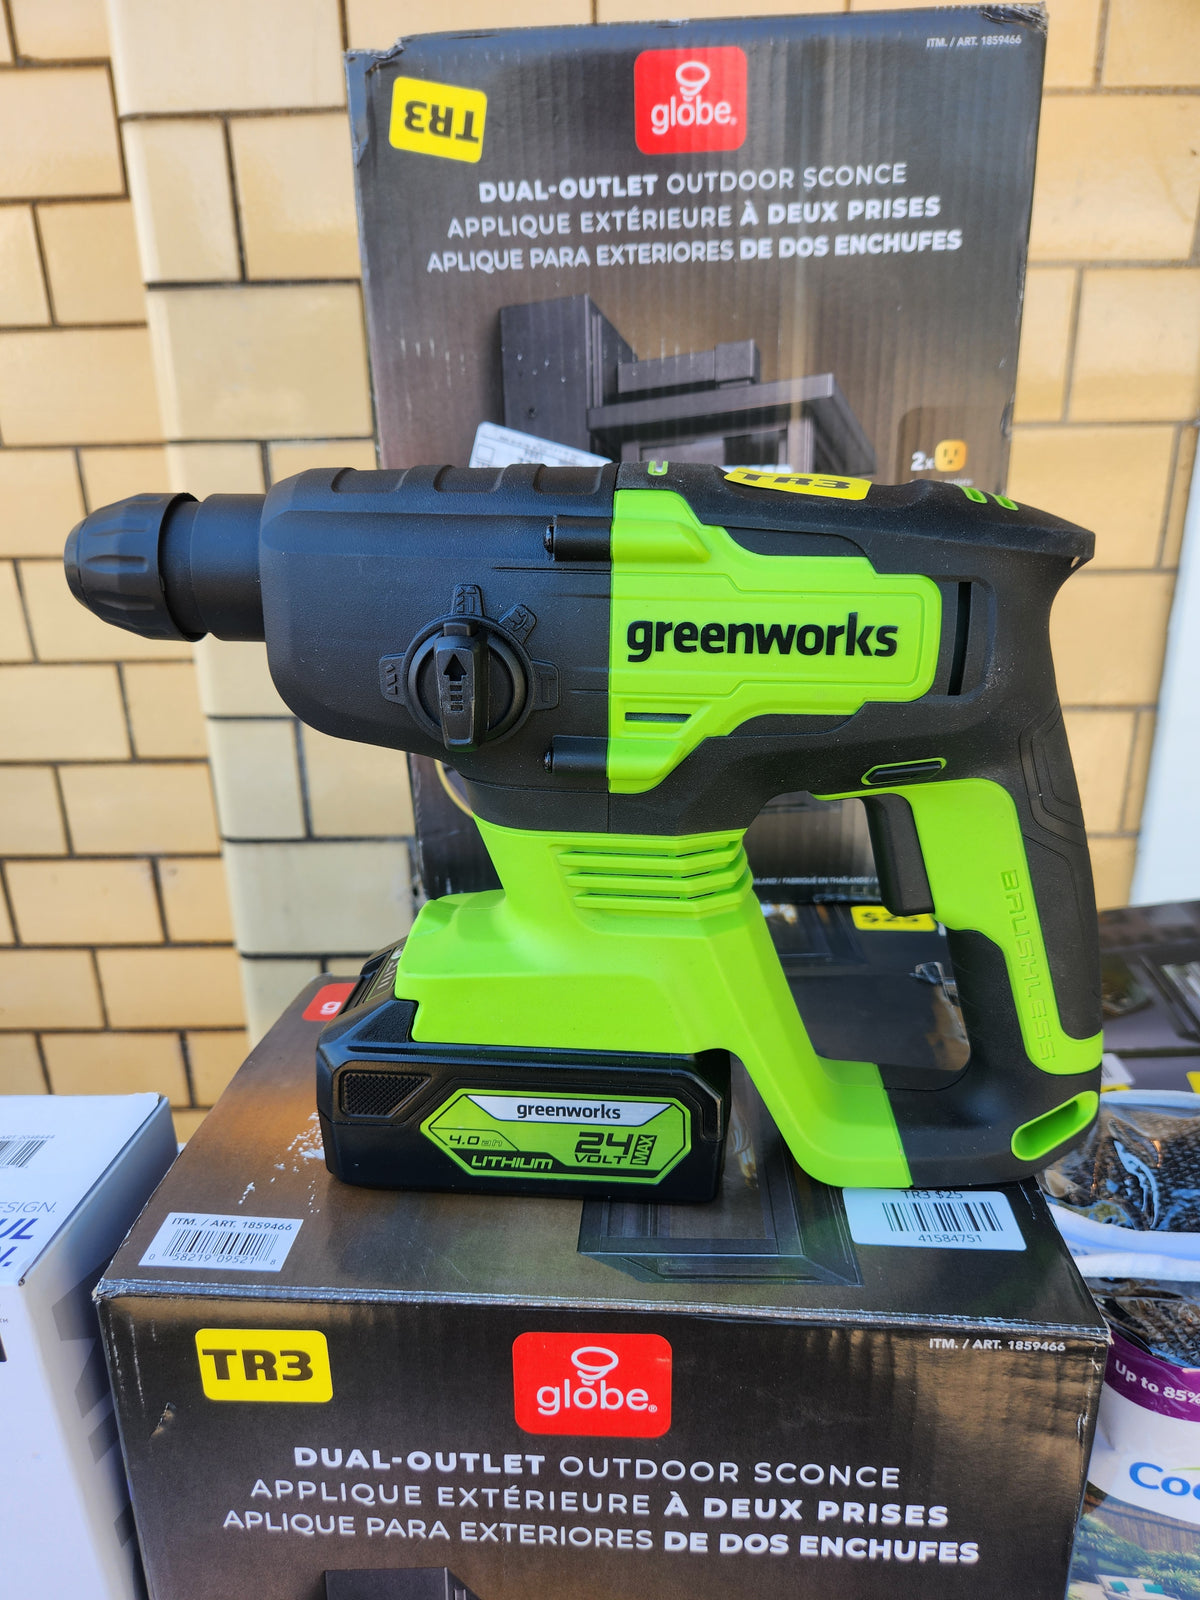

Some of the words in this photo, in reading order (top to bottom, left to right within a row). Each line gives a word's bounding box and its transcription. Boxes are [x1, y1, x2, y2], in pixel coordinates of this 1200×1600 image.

[981, 34, 1022, 46] 1859466
[404, 100, 479, 143] TR3
[479, 173, 659, 203] DUAL-OUTLET
[666, 167, 794, 195] OUTDOOR
[803, 162, 907, 189] SCONCE
[447, 212, 571, 239] APPLIQUE
[580, 205, 732, 234] EXTÉRIEURE
[740, 199, 759, 226] À
[768, 201, 838, 224] DEUX
[847, 195, 941, 221] PRISES
[427, 248, 524, 274] APLIQUE
[530, 246, 590, 269] PARA
[596, 239, 734, 267] EXTERIORES
[740, 237, 773, 260] DE
[779, 235, 829, 258] DOS
[835, 229, 962, 256] ENCHUFES
[737, 471, 850, 490] TR3
[627, 611, 898, 663] greenworks
[1001, 869, 1056, 1060] BRUSHLESS
[517, 1104, 621, 1120] greenworks
[575, 1131, 634, 1155] 24
[632, 1134, 655, 1165] MAX
[471, 1155, 554, 1170] LITHIUM
[575, 1154, 628, 1165] VOLT
[901, 1190, 932, 1200] TR3
[934, 1190, 964, 1200] $25
[172, 1218, 197, 1226] ITM.
[210, 1219, 237, 1228] ART.
[242, 1221, 292, 1231] 1859466
[918, 1234, 983, 1243] 41584751
[172, 1253, 212, 1262] 58219
[216, 1256, 256, 1264] 09521
[929, 1338, 960, 1349] ITM.
[972, 1339, 1003, 1350] ART.
[1007, 1340, 1066, 1352] 1859466
[202, 1348, 314, 1382] TR3
[1115, 1360, 1137, 1382] Up
[1141, 1376, 1159, 1393] to
[1163, 1386, 1200, 1405] 85%
[293, 1446, 546, 1475] DUAL-OUTLET
[559, 1456, 739, 1483] OUTDOOR
[754, 1462, 900, 1489] SCONCE
[1129, 1462, 1200, 1500] Co
[250, 1479, 422, 1507] APPLIQUE
[438, 1483, 650, 1516] EXTÉRIEURE
[664, 1491, 689, 1517] À
[703, 1498, 803, 1521] DEUX
[817, 1500, 949, 1527] PRISES
[223, 1510, 356, 1536] APLIQUE
[367, 1516, 450, 1539] PARA
[461, 1522, 653, 1550] EXTERIORES
[664, 1531, 708, 1552] DE
[719, 1533, 789, 1555] DOS
[800, 1535, 980, 1564] ENCHUFES
